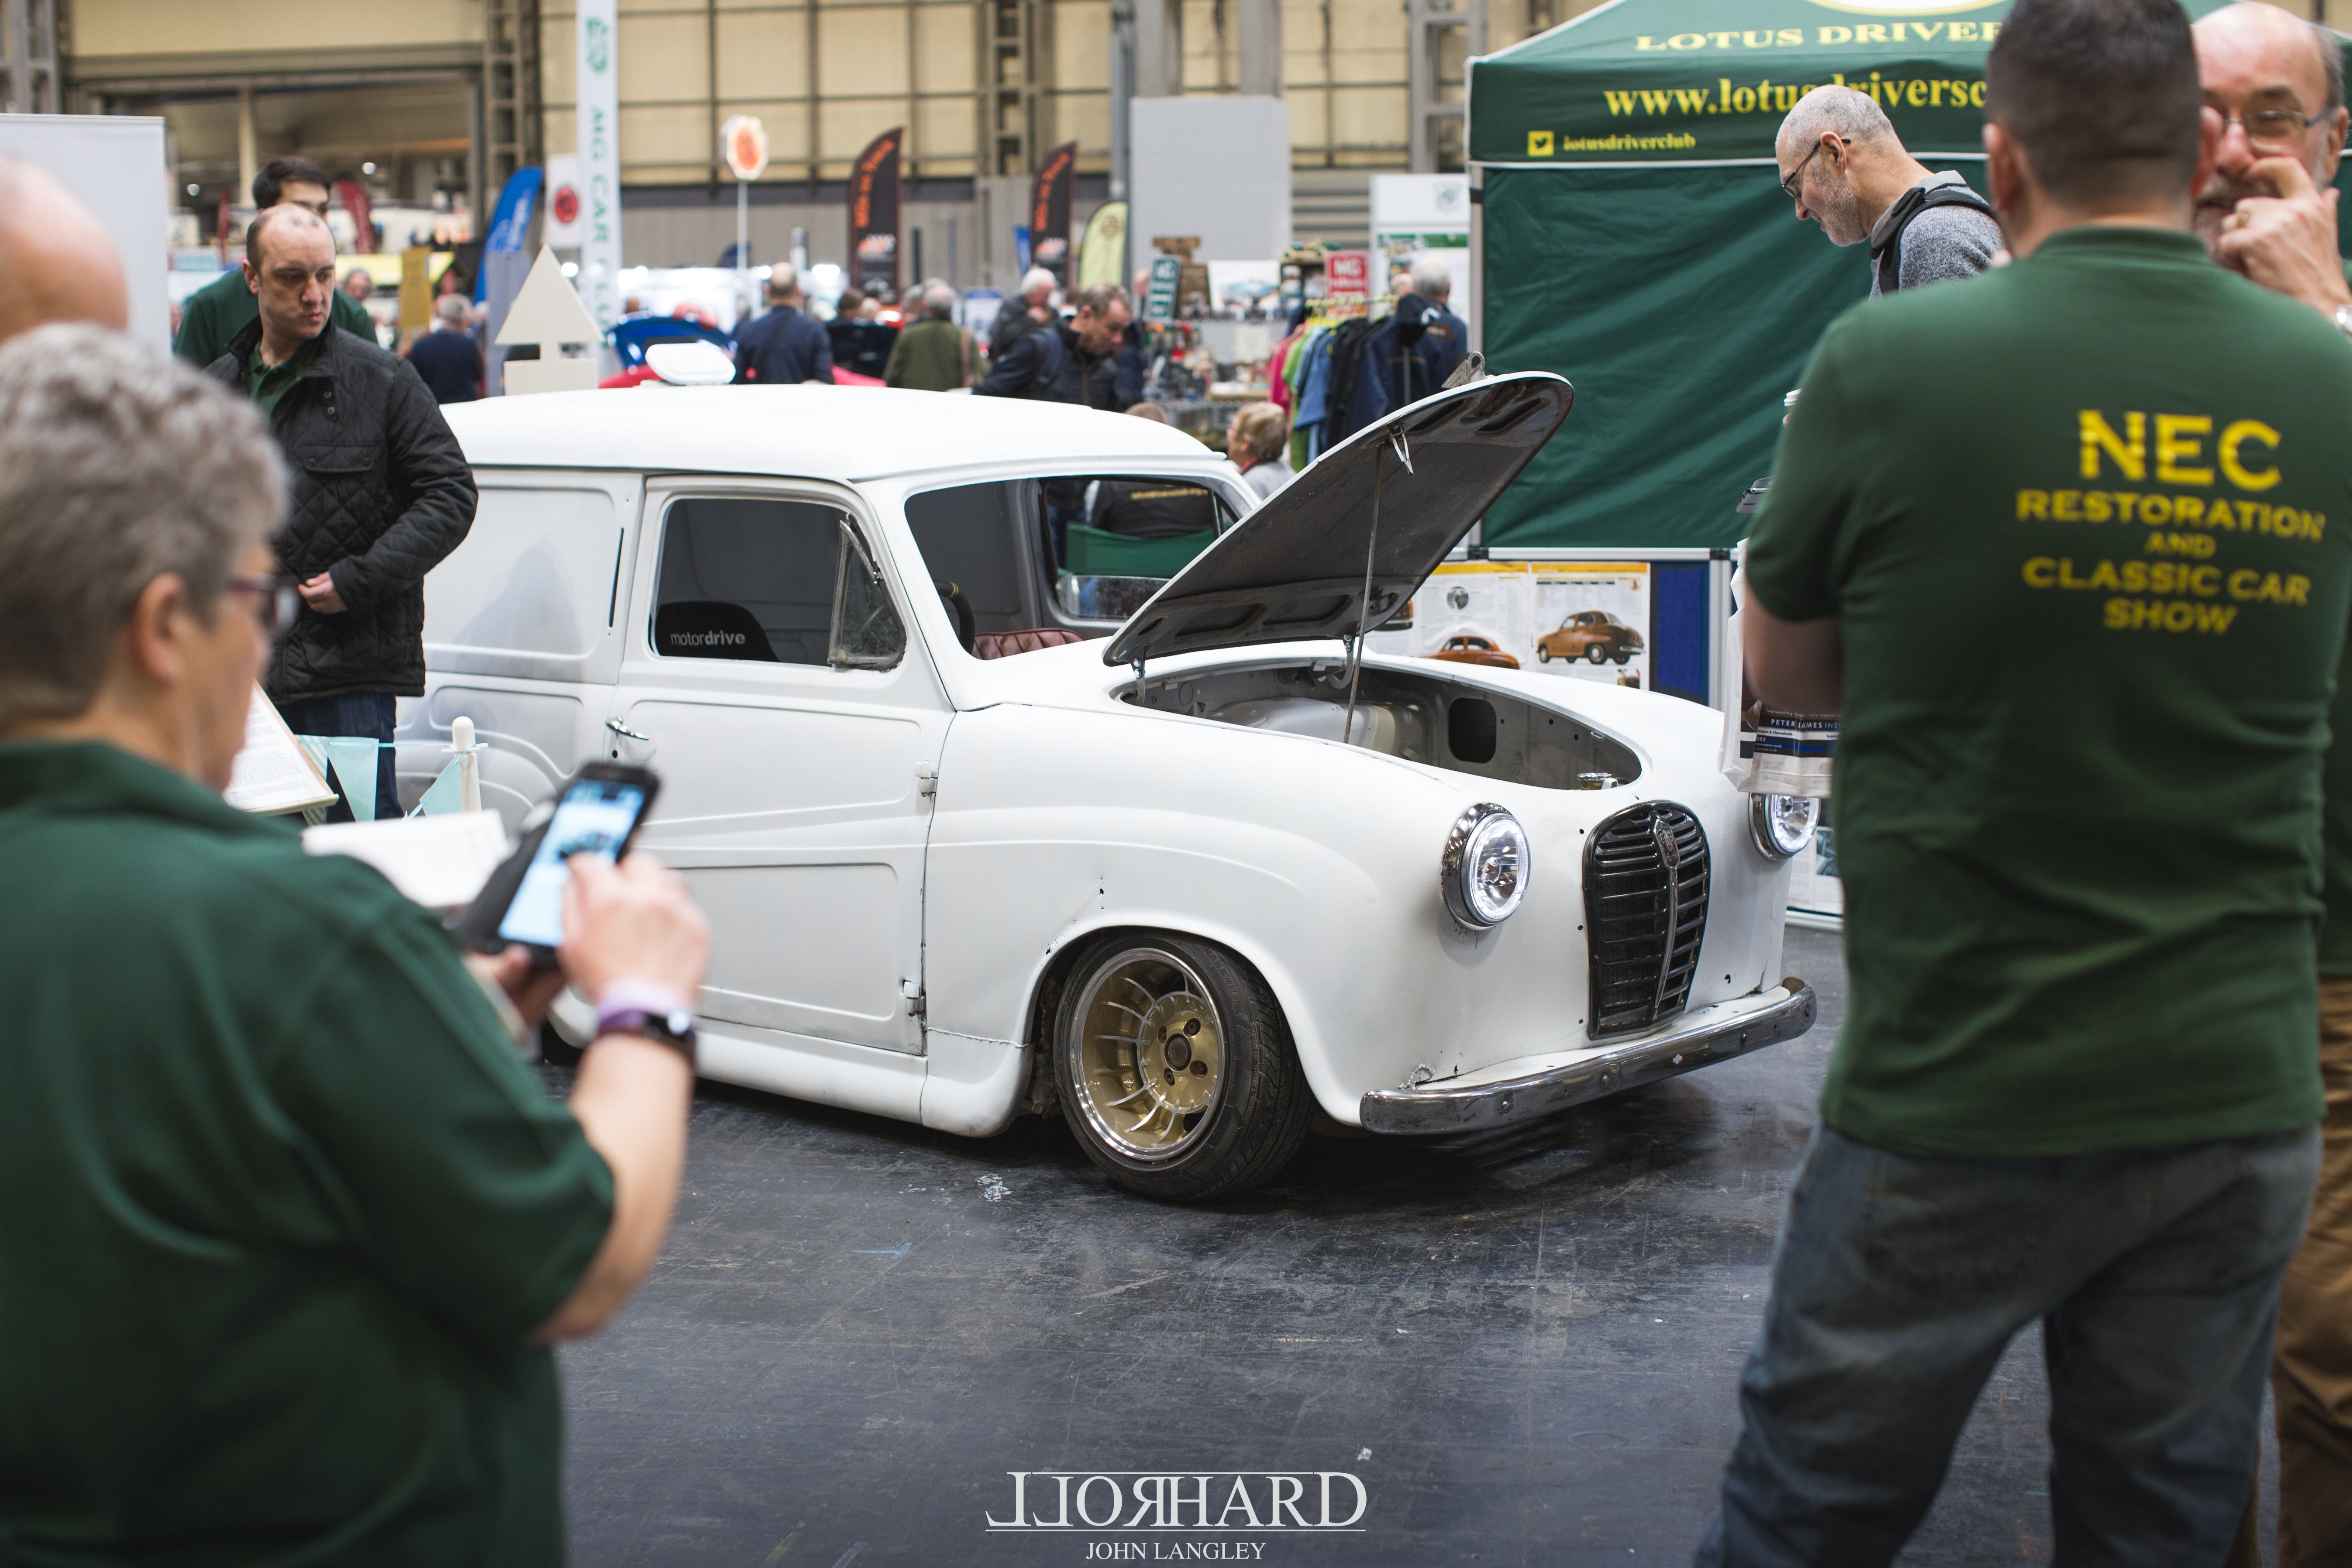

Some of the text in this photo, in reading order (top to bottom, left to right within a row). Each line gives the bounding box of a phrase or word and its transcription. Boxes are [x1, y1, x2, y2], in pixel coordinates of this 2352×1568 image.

[1635, 28, 1804, 51] LOTUS
[1563, 132, 1696, 151] lotusdriverclub
[591, 173, 609, 245] CAR
[2078, 409, 2282, 490] NEC
[2015, 489, 2327, 542] RESTORATION
[2145, 531, 2216, 559] AND
[2021, 557, 2311, 606] CLASSIC CAR
[2103, 597, 2238, 635] SHOW
[670, 630, 746, 647] motordrive
